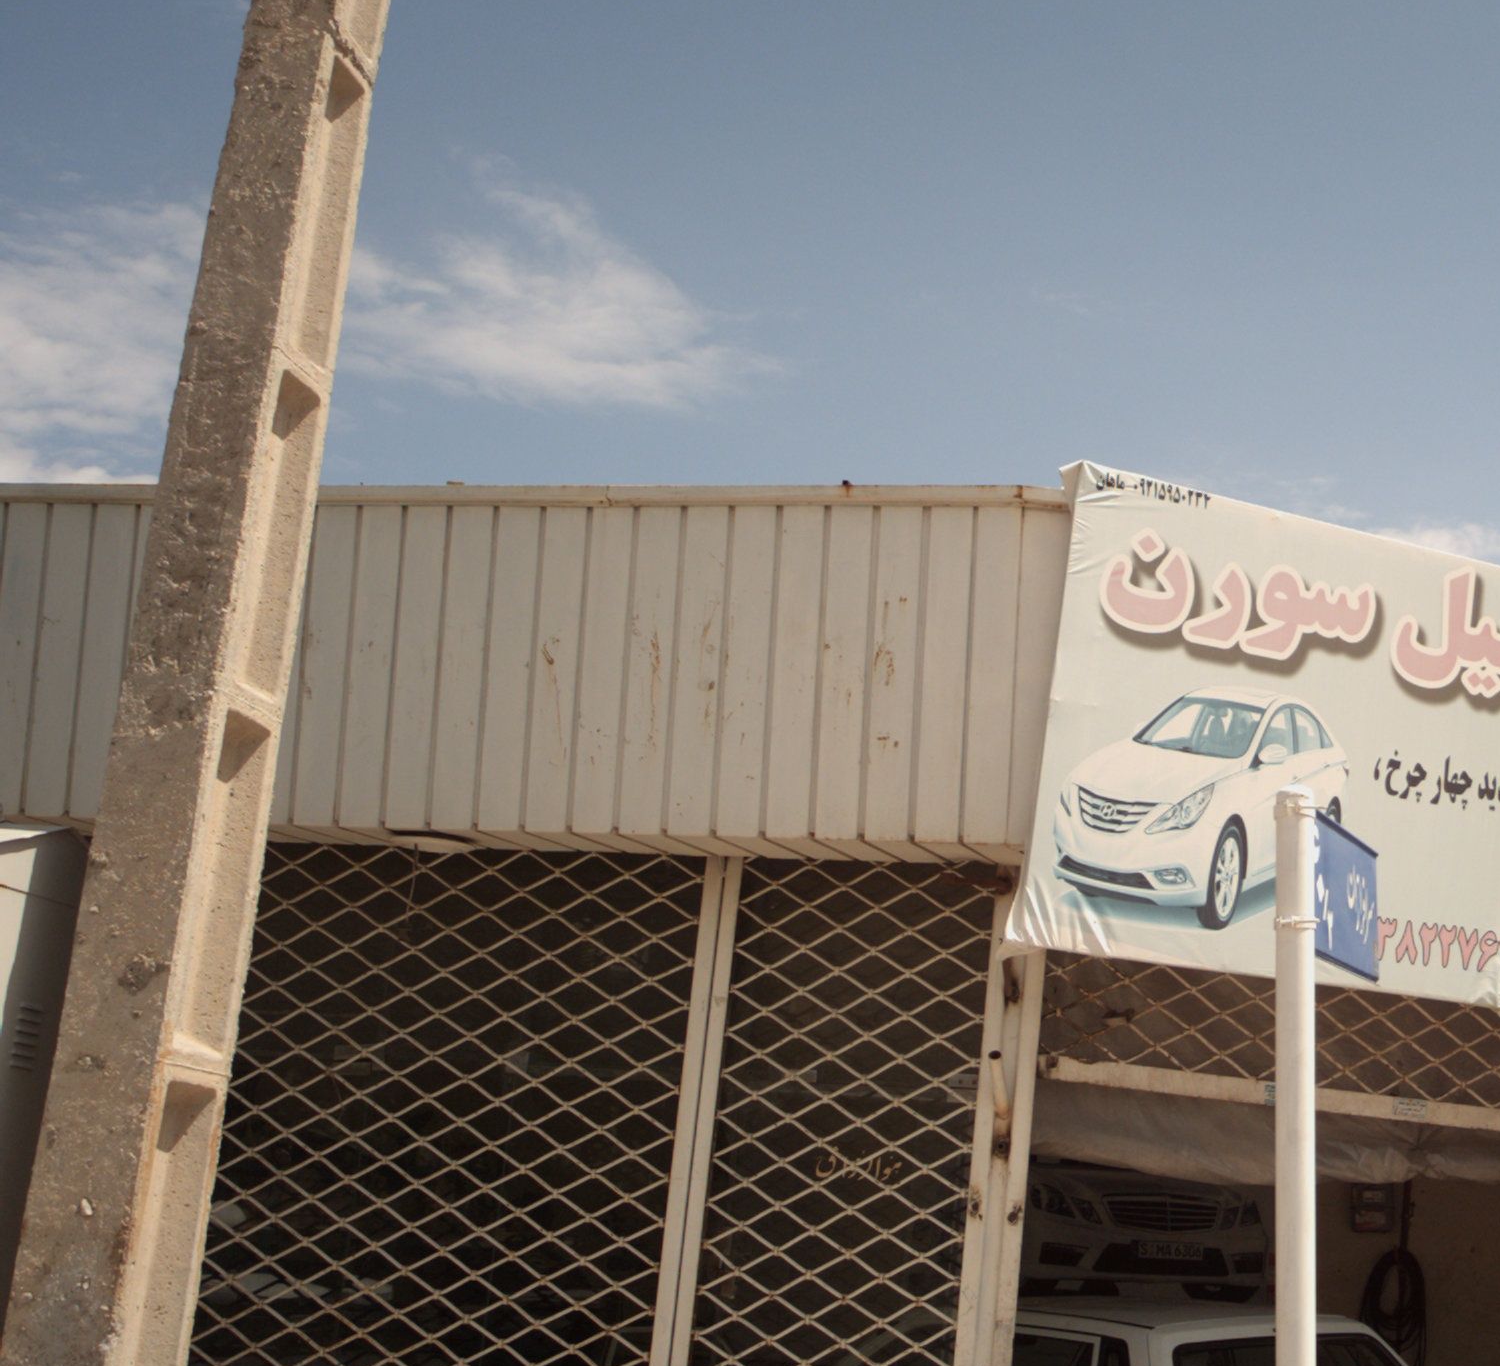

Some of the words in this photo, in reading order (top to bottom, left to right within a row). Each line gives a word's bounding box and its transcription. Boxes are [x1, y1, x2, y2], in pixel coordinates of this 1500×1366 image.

[1100, 527, 1376, 661] سورن
[1384, 748, 1428, 803] چرخ
[1429, 754, 1473, 811] چهار
